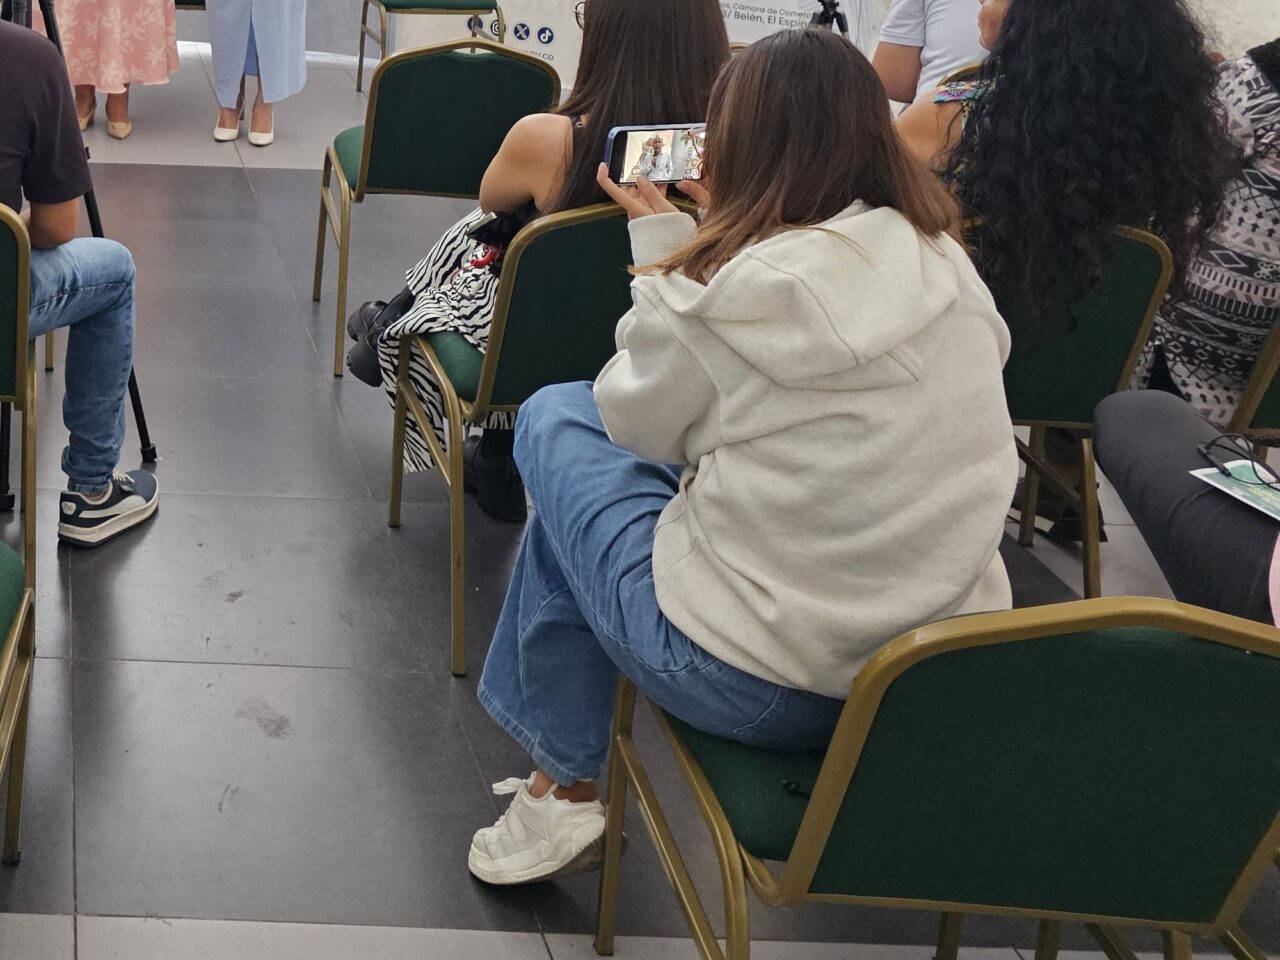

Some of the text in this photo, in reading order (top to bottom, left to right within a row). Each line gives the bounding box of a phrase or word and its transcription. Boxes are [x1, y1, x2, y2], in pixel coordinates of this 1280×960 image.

[733, 2, 766, 14] Cámara
[767, 7, 778, 15] de
[734, 10, 765, 24] Belén,
[767, 14, 776, 24] El
[779, 17, 807, 29] Espin
